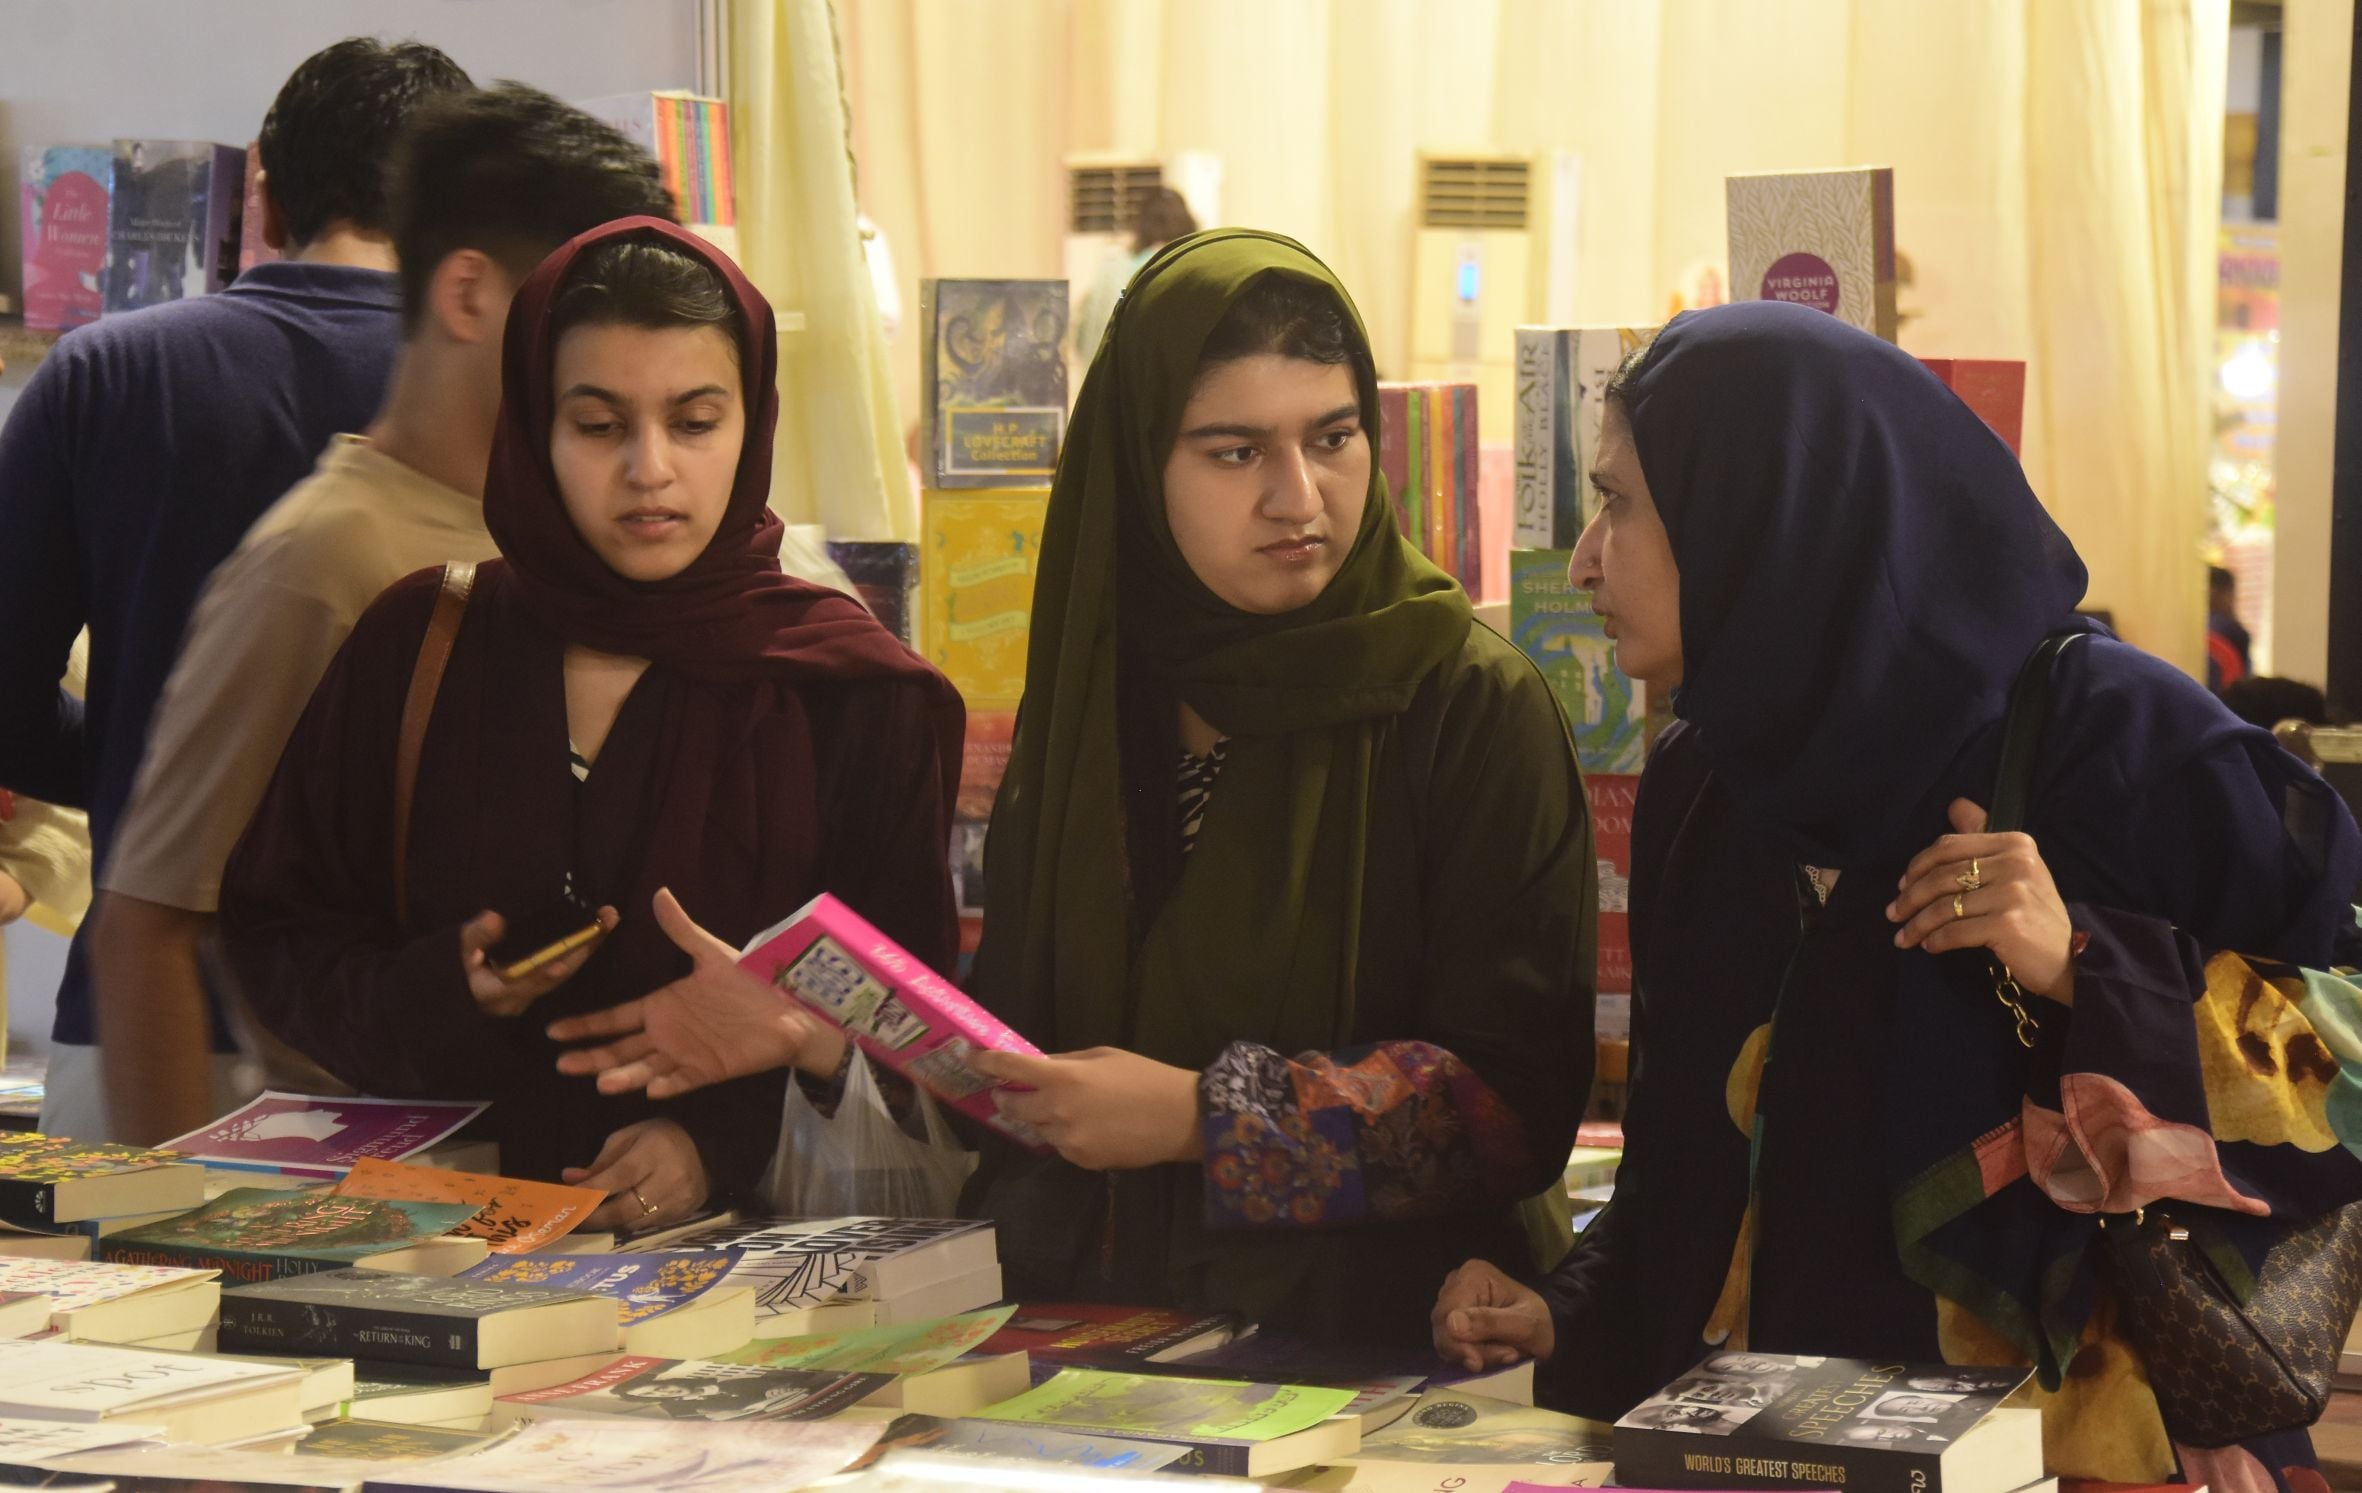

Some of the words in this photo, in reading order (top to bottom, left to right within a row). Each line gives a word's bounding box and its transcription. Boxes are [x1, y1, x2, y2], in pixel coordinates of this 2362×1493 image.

[52, 202, 92, 222] Little
[47, 224, 101, 246] Women
[1767, 276, 1834, 289] VIRGINIA
[1775, 289, 1828, 301] WOOLF
[1519, 343, 1538, 414] AIR
[1537, 346, 1549, 431] BLACK
[963, 432, 1047, 448] LOVECRAFT
[970, 450, 1037, 461] Collection
[1538, 447, 1549, 532] HOLLY
[1522, 581, 1590, 595] SHER
[1534, 602, 1591, 614] HOLM
[326, 1114, 430, 1164] Sigmund
[115, 1249, 192, 1270] GATHERING
[198, 1257, 273, 1282] MIDNIGHT
[276, 1257, 321, 1275] HOLLY
[588, 1264, 641, 1292] TUS
[243, 1325, 285, 1337] TOLKIEN
[359, 1330, 398, 1345] RETURN
[404, 1334, 432, 1349] KING
[570, 1360, 649, 1390] FRANK
[1781, 1378, 1845, 1422] GREATEST
[1788, 1363, 1907, 1439] SPEECHES
[1683, 1453, 1731, 1475] WORLD'S
[1735, 1457, 1788, 1479] GREATEST
[1790, 1461, 1846, 1484] SPEECHES
